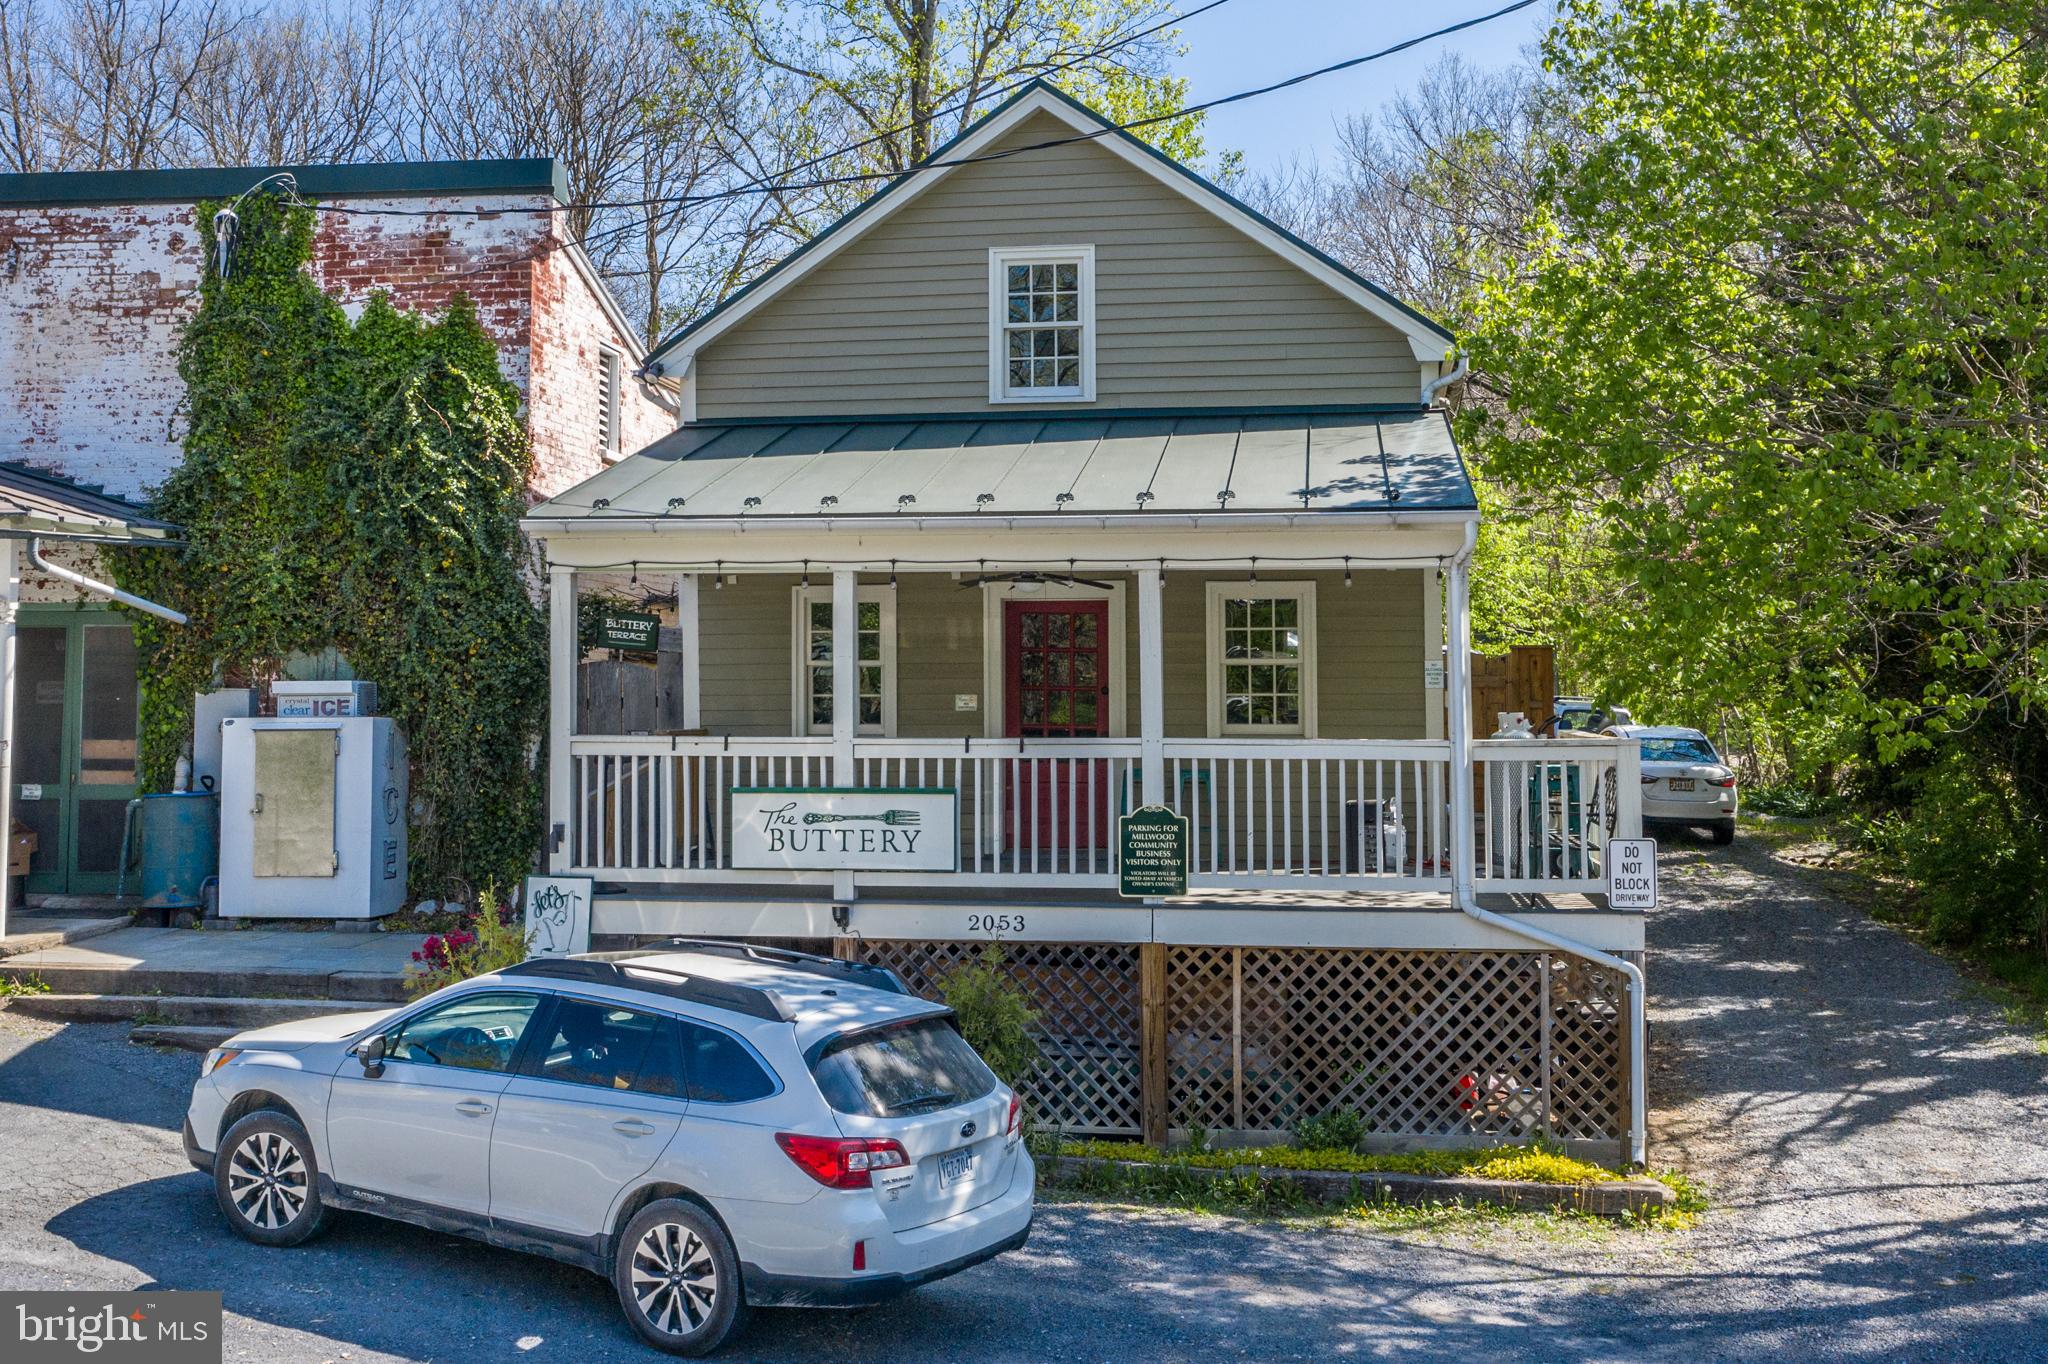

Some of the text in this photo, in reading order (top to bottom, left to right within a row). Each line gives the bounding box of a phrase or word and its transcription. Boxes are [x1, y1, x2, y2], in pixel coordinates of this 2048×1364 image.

[605, 618, 654, 631] BUTTERY
[607, 630, 648, 641] TERRACE
[283, 699, 351, 716] clear ICE
[759, 802, 798, 833] The
[1128, 824, 1179, 832] PARKING FOR
[768, 828, 922, 853] BUTTERY
[1129, 841, 1178, 849] COMMUNITY
[1624, 846, 1640, 858] DO
[1125, 858, 1182, 866] VISITORS ONLY
[1622, 862, 1643, 874] NOT
[1615, 878, 1650, 890] BLOCK
[1616, 893, 1650, 902] DRIVEWAY
[968, 914, 1026, 932] 2053
